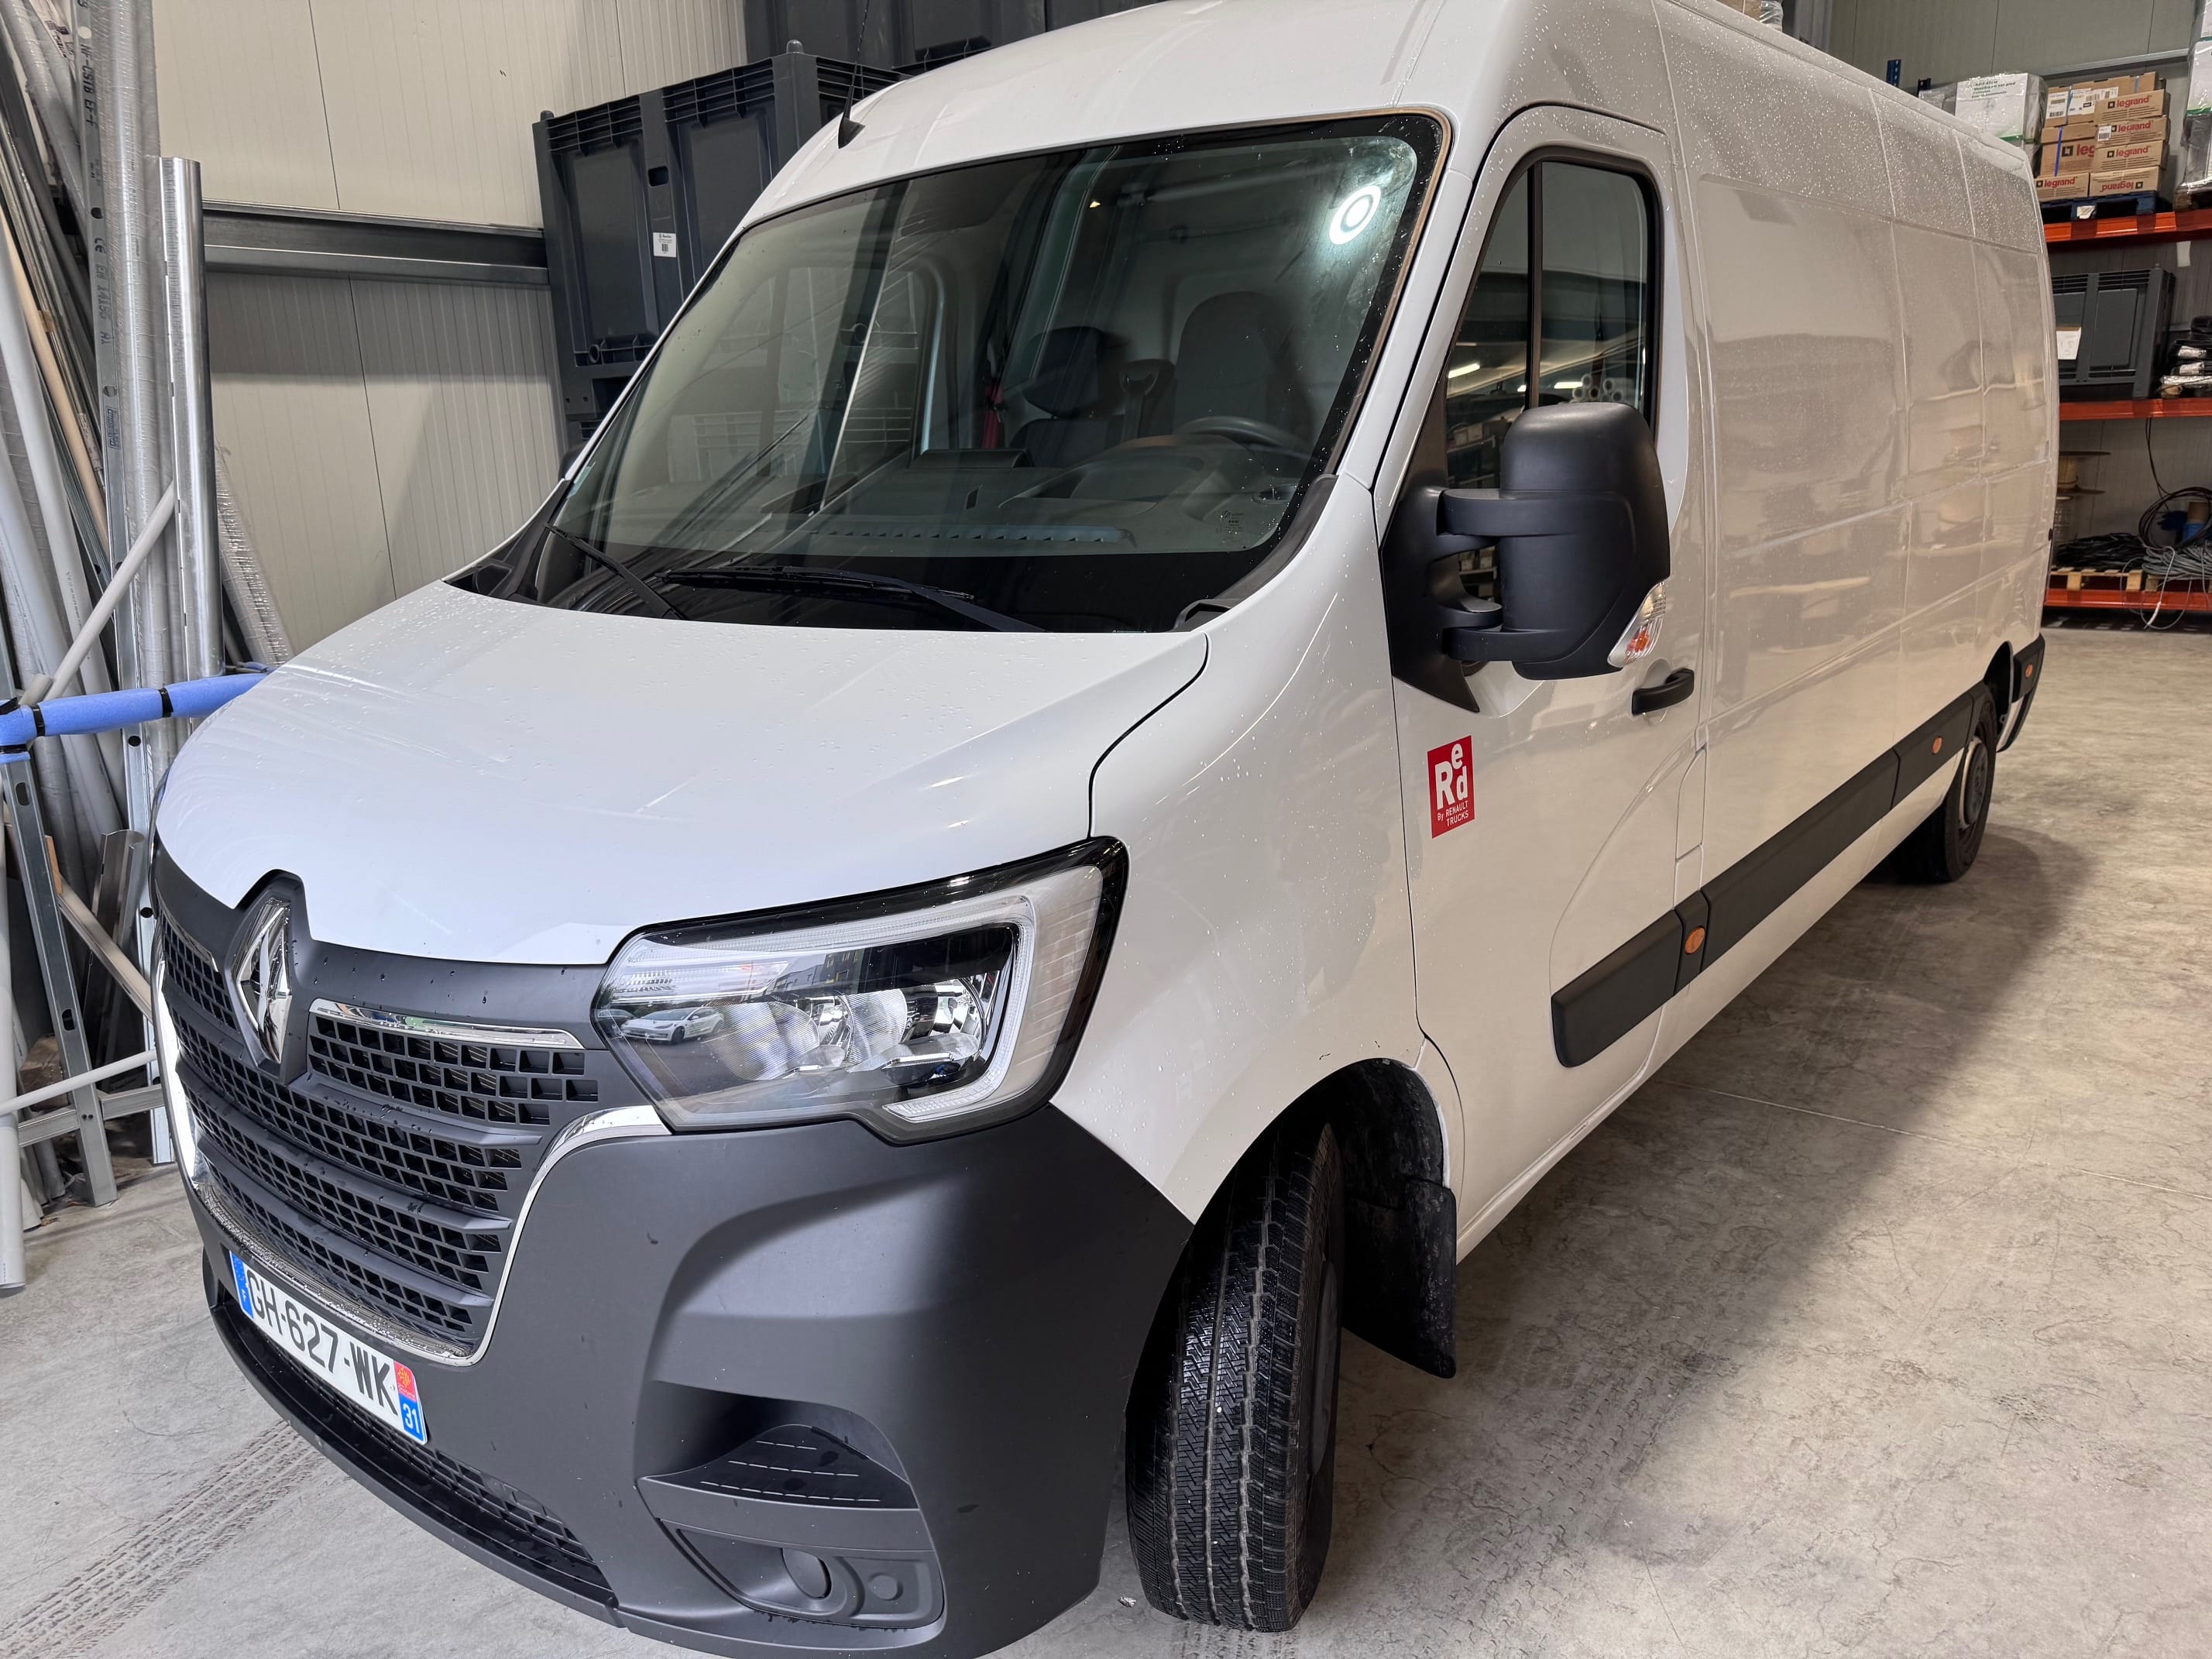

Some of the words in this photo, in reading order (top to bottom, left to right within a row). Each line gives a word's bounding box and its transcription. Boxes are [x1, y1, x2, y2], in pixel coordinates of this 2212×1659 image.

[2117, 95, 2149, 108] legrand
[2116, 146, 2148, 157] legrand
[2044, 177, 2075, 187] legrand
[2101, 181, 2134, 192] legrand
[1445, 800, 1468, 817] RENAULT
[1446, 810, 1469, 826] TRUCKS
[247, 1269, 398, 1416] GH-627-WK
[403, 1403, 421, 1434] 31
